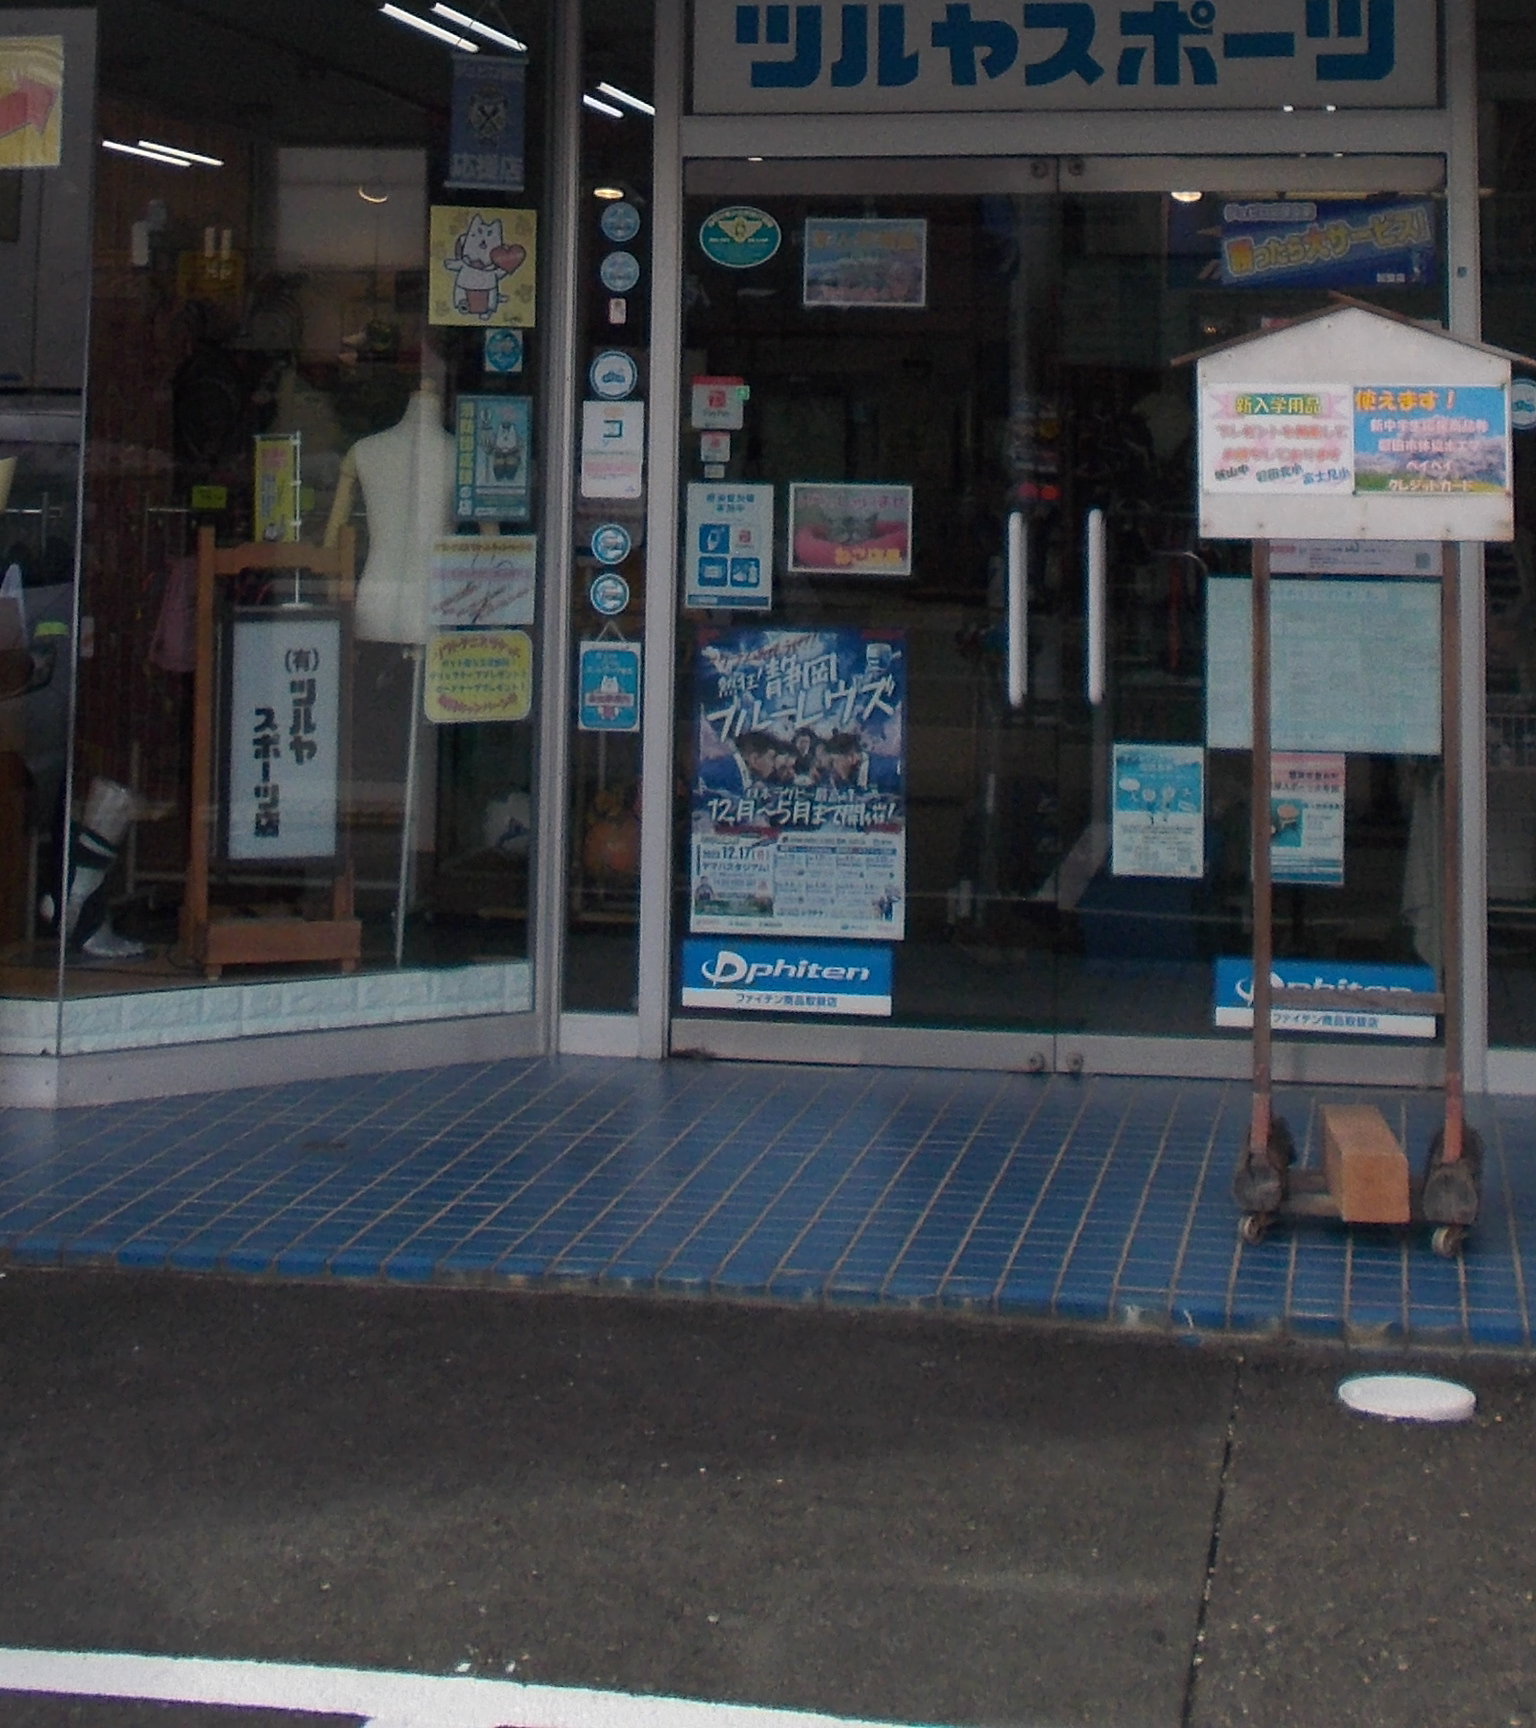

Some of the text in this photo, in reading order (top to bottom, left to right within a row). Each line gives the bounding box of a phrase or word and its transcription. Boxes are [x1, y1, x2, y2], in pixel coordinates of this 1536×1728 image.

[1235, 396, 1321, 414] 新入学用品
[765, 652, 837, 700] 静岡
[252, 706, 281, 838] スポーツ店
